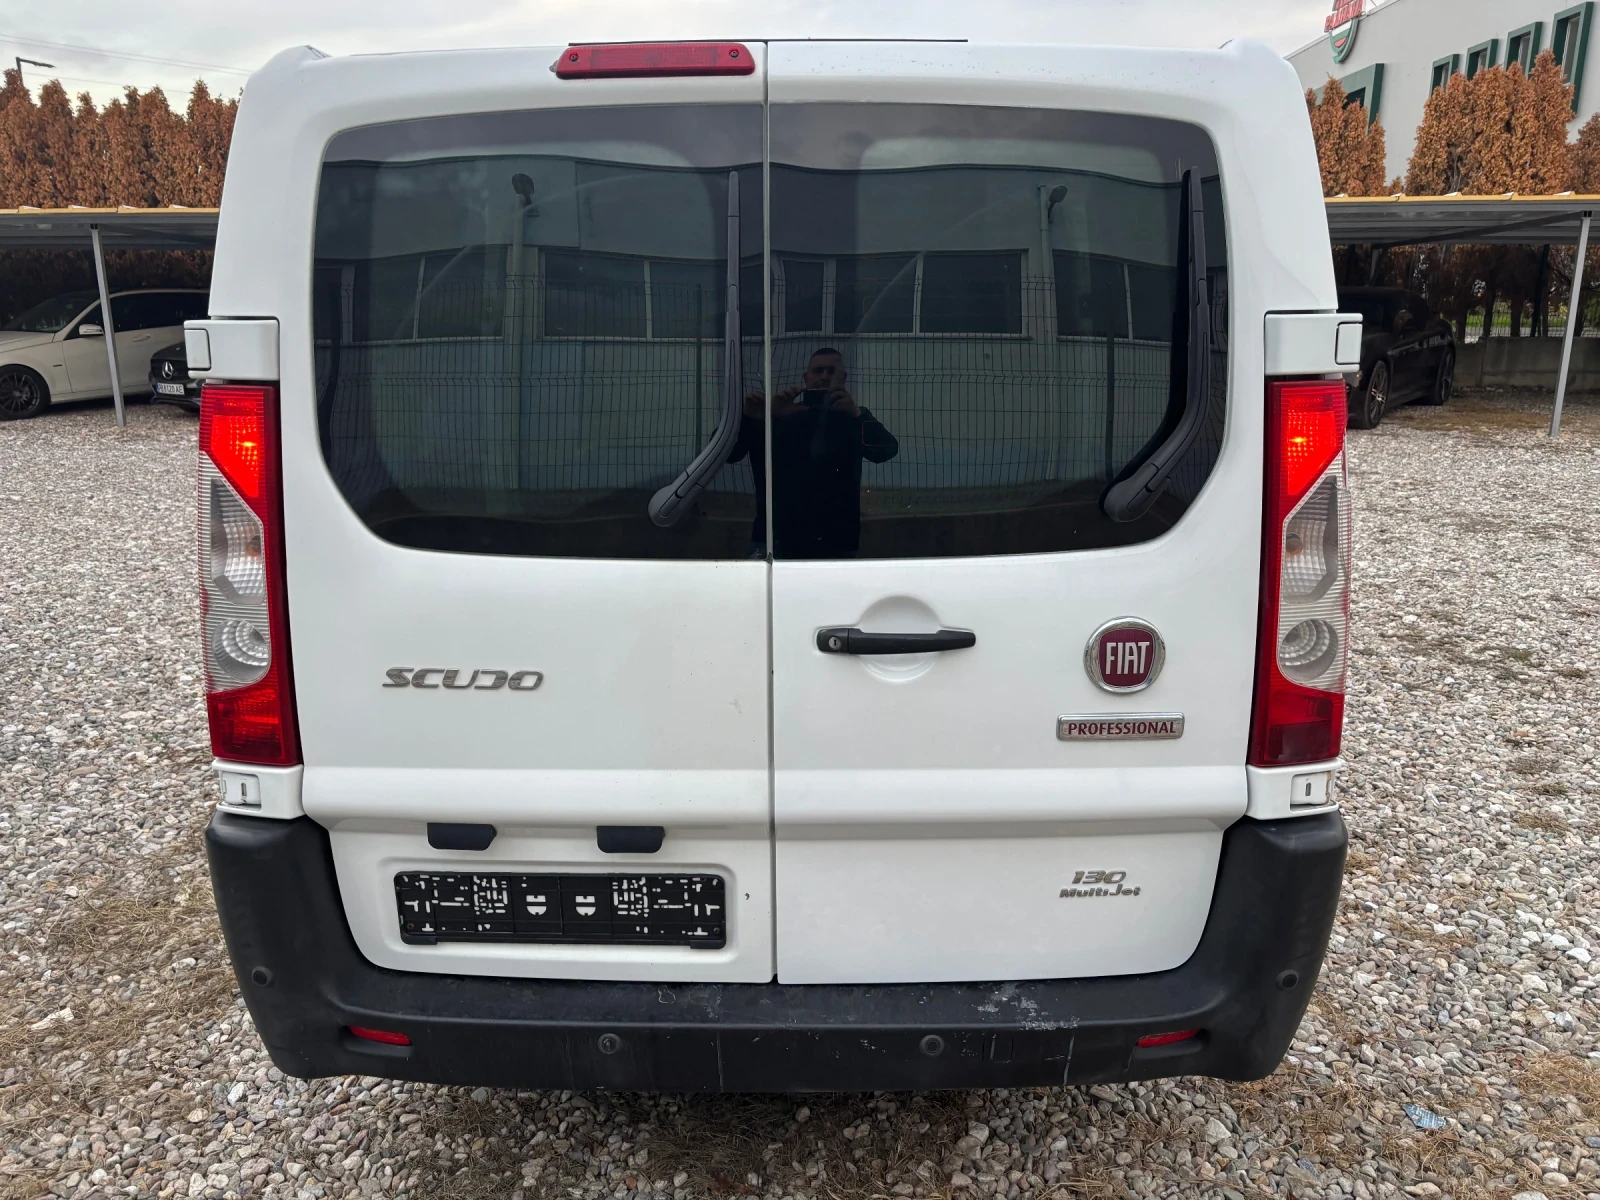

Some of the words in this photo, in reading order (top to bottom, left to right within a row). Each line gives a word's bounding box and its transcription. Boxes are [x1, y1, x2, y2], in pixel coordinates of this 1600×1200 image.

[1105, 641, 1150, 675] FIAT
[382, 667, 544, 691] SCUDO
[1068, 721, 1176, 735] PROFESSIONAL
[1072, 869, 1127, 884] 130
[1059, 883, 1141, 898] MultiJet
